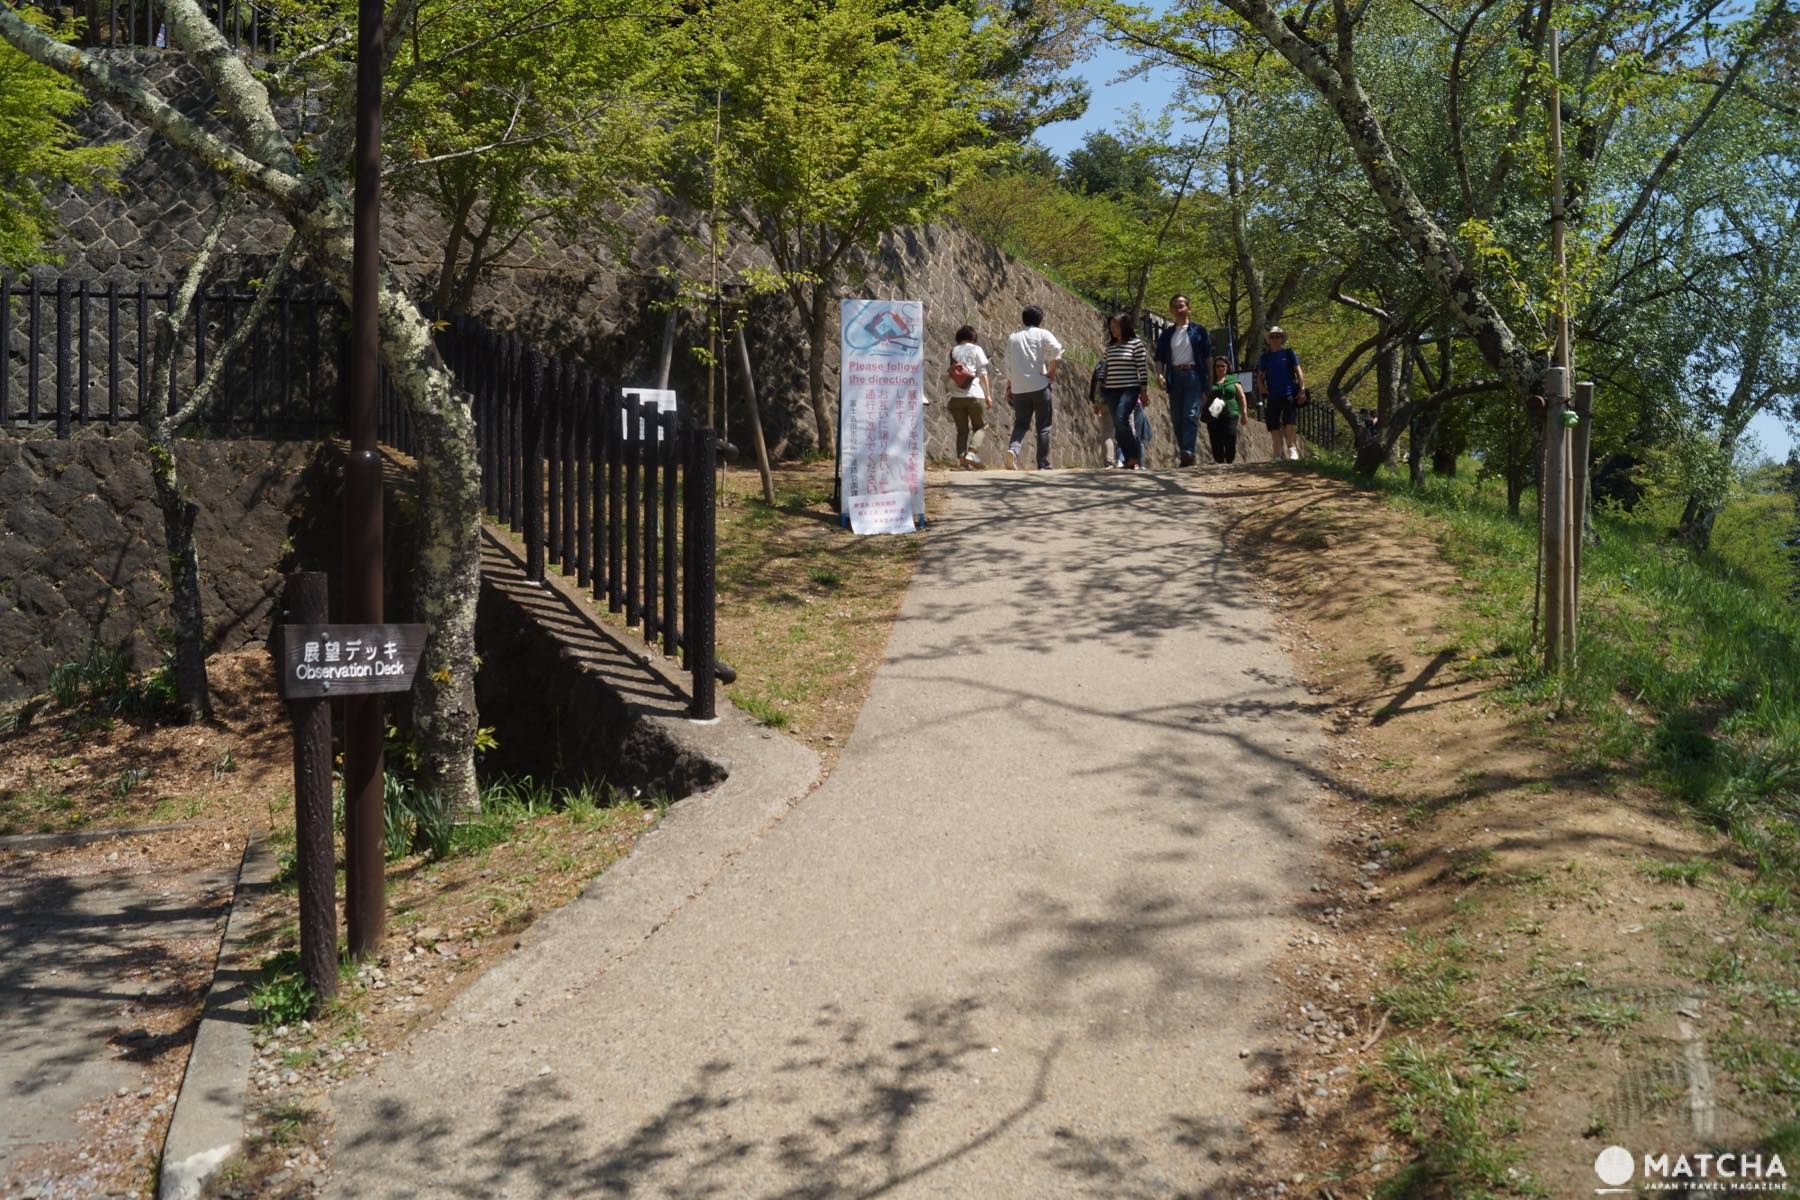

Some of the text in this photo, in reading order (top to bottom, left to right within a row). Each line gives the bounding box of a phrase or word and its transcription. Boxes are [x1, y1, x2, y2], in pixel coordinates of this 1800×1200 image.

[849, 361, 918, 372] Please follow
[849, 374, 918, 385] the direction.
[304, 639, 398, 662] 展望デッキ
[296, 660, 405, 680] Observation Deck
